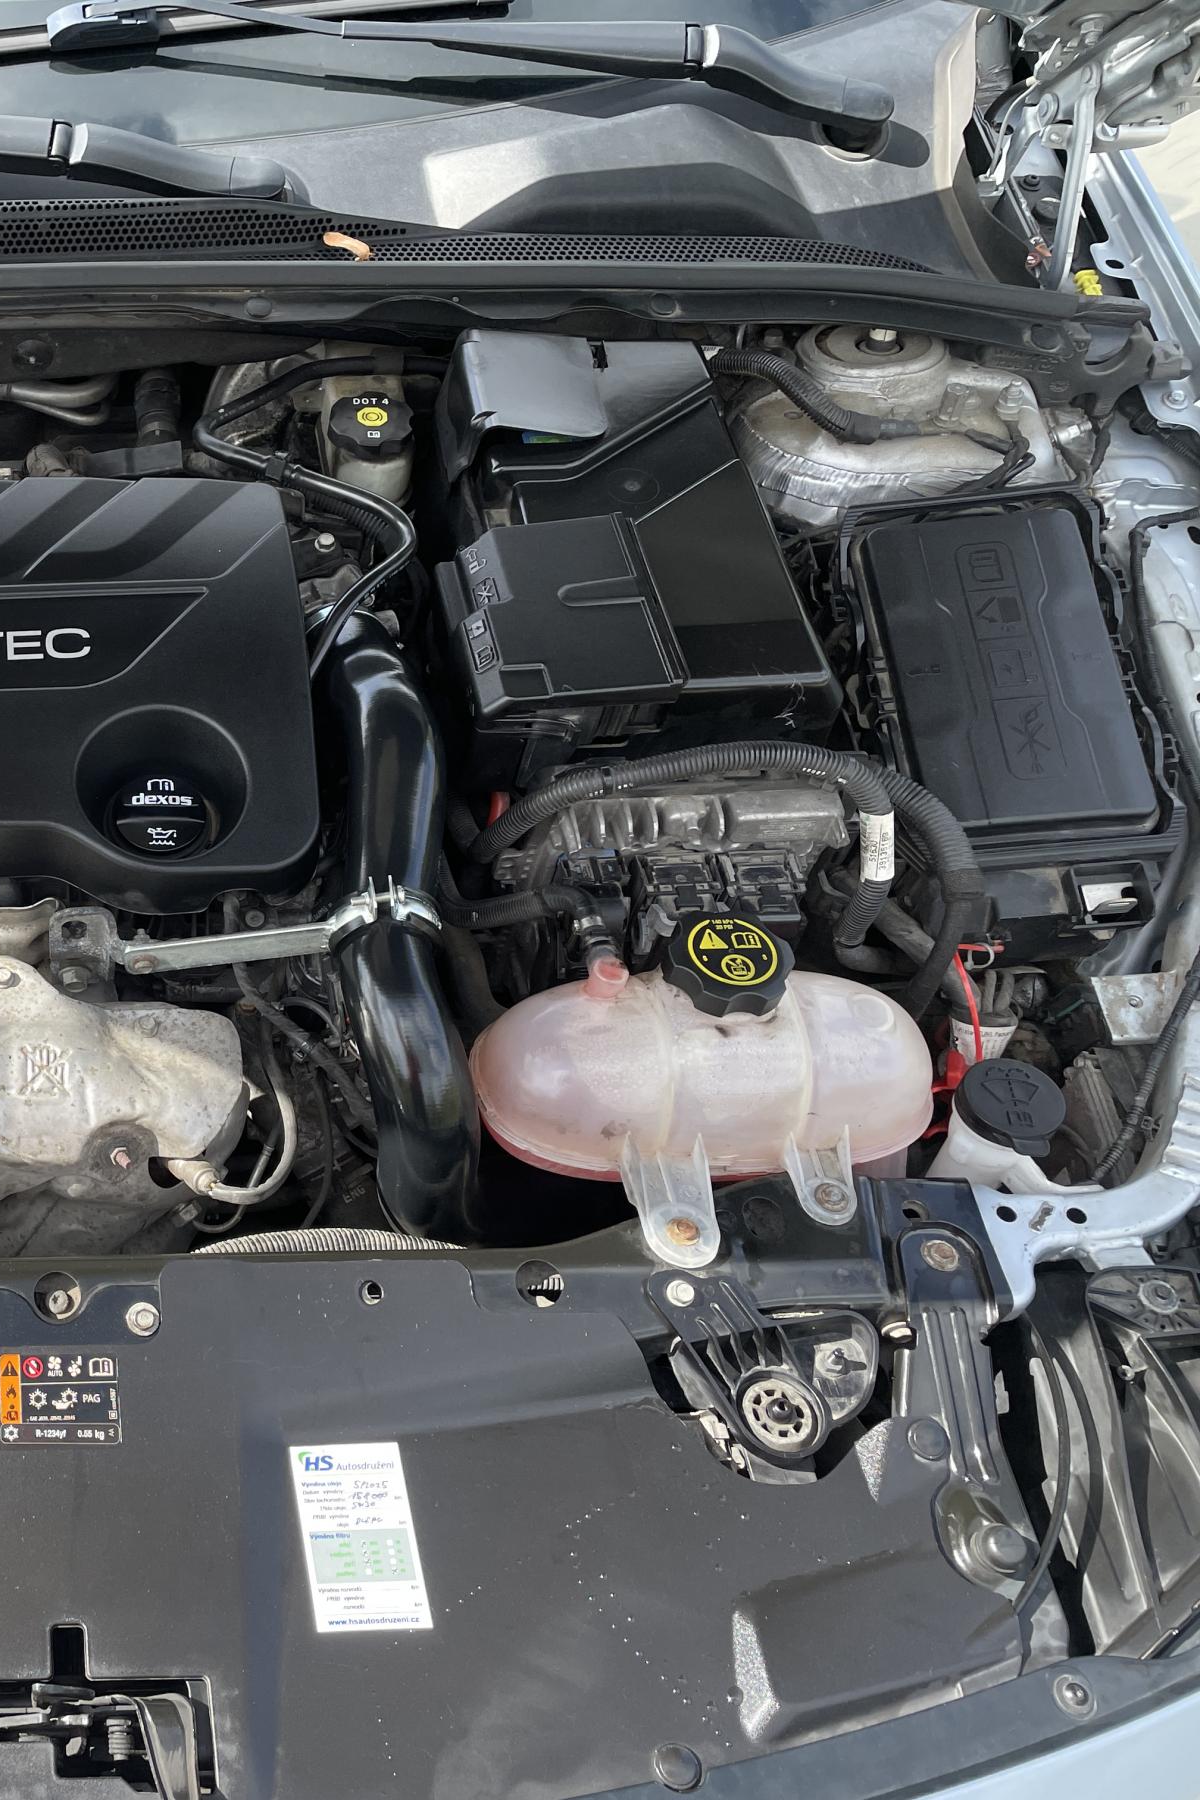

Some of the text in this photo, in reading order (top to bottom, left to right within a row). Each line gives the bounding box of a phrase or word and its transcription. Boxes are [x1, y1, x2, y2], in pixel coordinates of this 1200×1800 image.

[131, 793, 194, 806] dexos
[82, 1394, 101, 1403] PAG
[35, 1429, 105, 1440] R-1234yf 0.55 kg
[304, 1455, 334, 1472] HS
